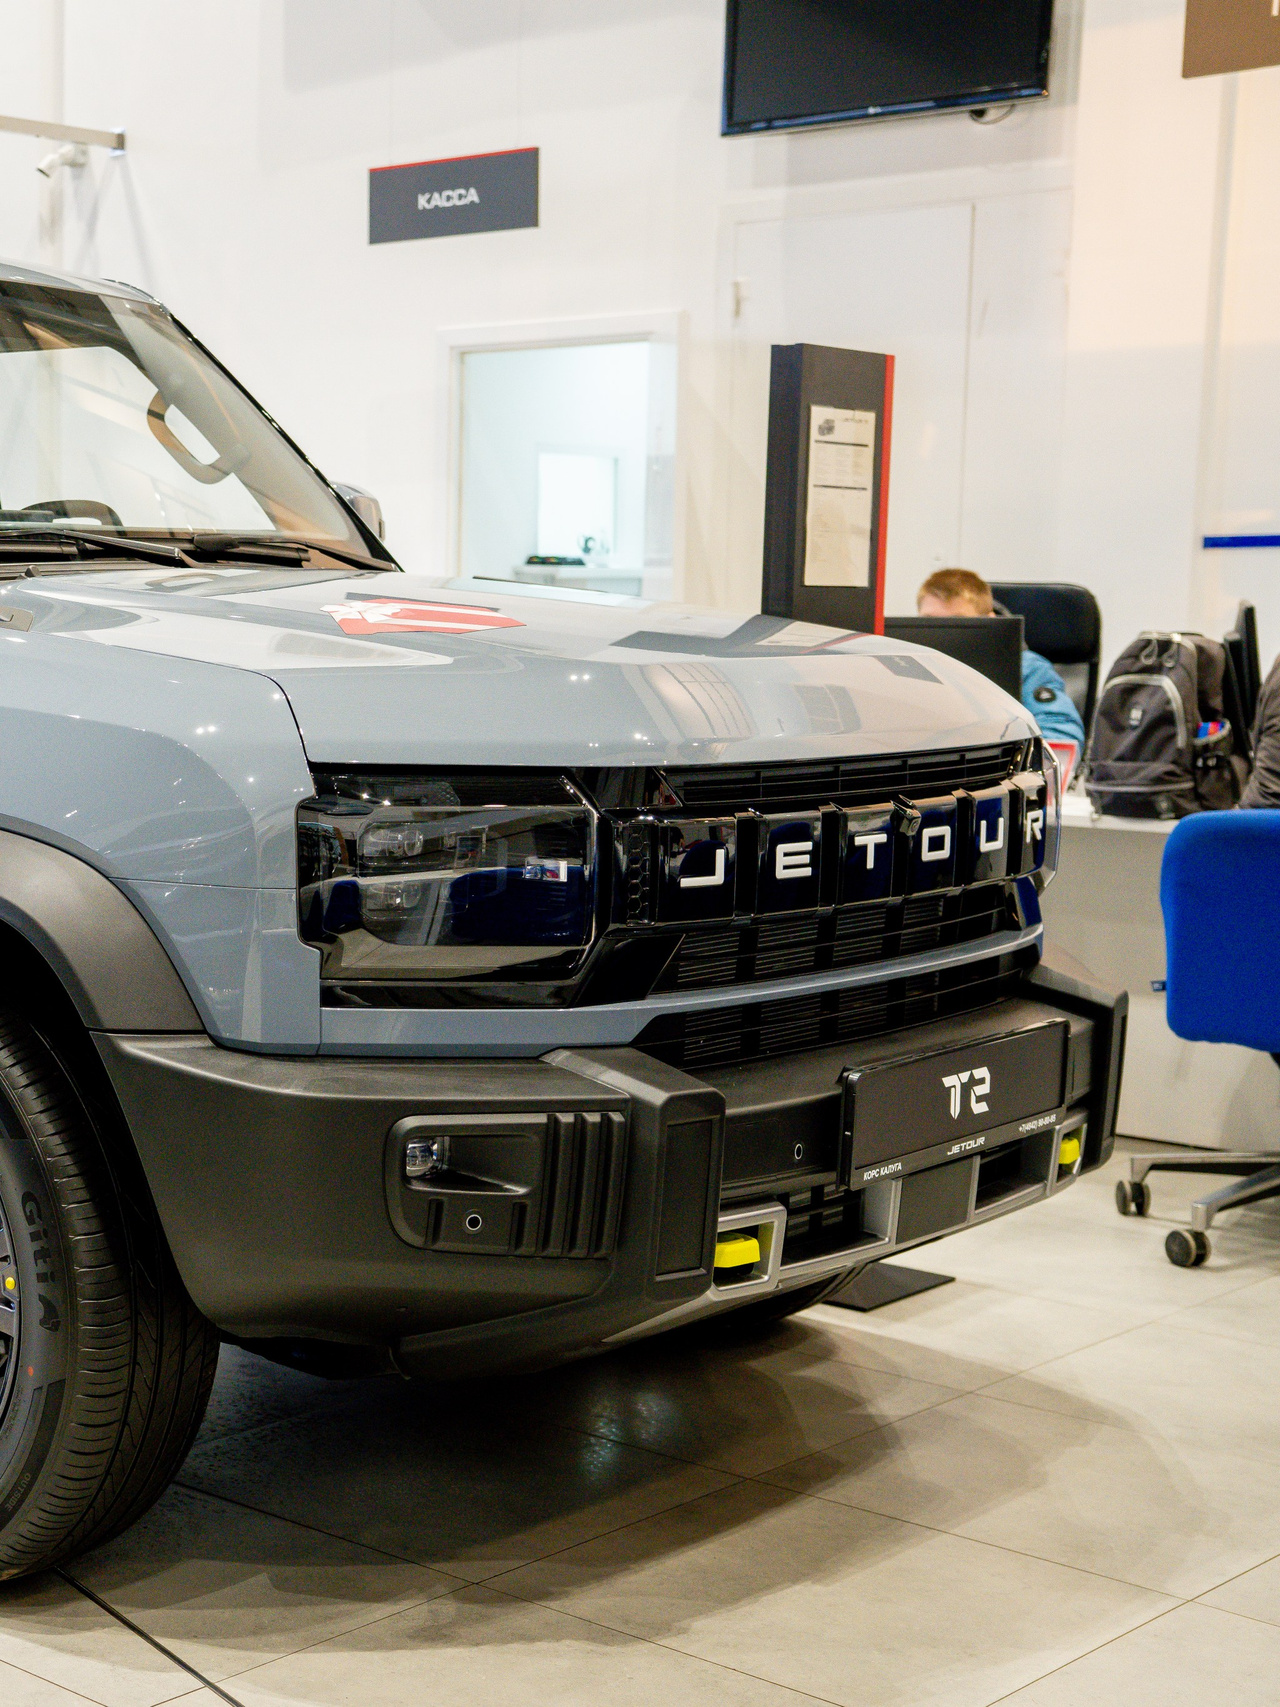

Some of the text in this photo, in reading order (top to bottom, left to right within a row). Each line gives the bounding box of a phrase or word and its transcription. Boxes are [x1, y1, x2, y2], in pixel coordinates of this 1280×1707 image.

[417, 186, 480, 211] КАССА
[680, 809, 1043, 888] JETOUR
[941, 1066, 991, 1120] T2
[947, 1136, 986, 1156] JETOUR
[863, 1162, 902, 1181] КОРС КАЛУГА
[3, 1472, 32, 1513] OUTSIDE
